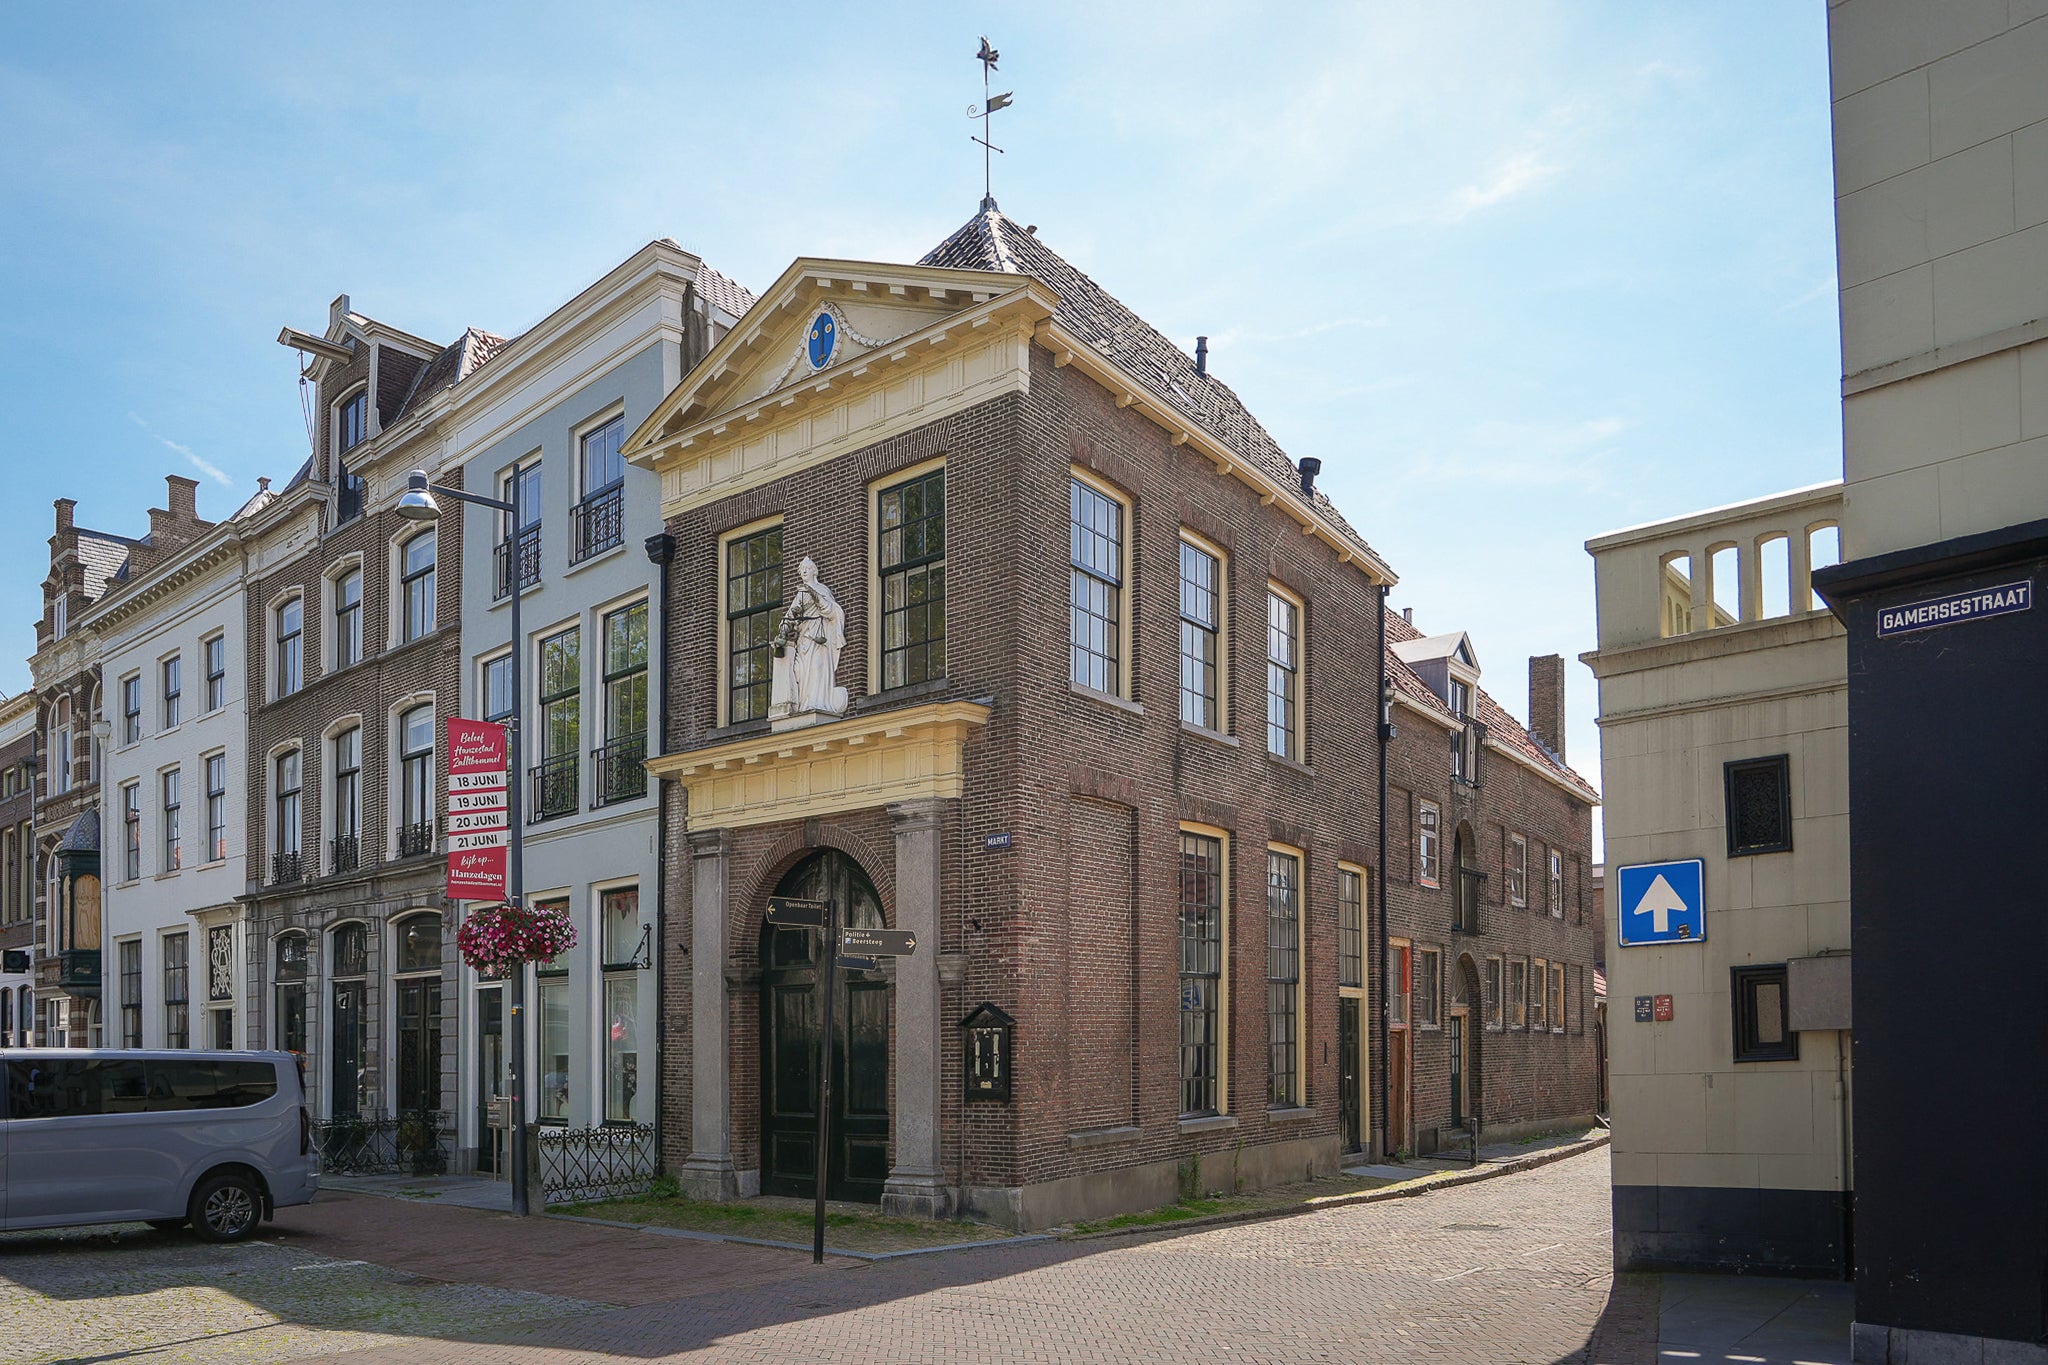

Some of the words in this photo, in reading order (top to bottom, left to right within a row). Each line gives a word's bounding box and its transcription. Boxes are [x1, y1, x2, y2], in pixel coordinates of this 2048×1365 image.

[1883, 587, 2027, 629] GAMERSESTRAAT
[460, 732, 485, 744] Beleef
[453, 742, 495, 756] Hanzestad
[457, 776, 470, 787] 18
[472, 774, 499, 786] JUNI
[457, 797, 470, 808] 19
[472, 795, 499, 807] JUNI
[456, 817, 471, 828] 20
[473, 814, 500, 826] JUNI
[457, 837, 469, 848] 21
[471, 834, 498, 846] JUNI
[987, 836, 1008, 847] MARKT
[460, 854, 477, 869] kijk
[451, 869, 503, 882] Hanzedagen
[785, 901, 807, 909] Openbaar
